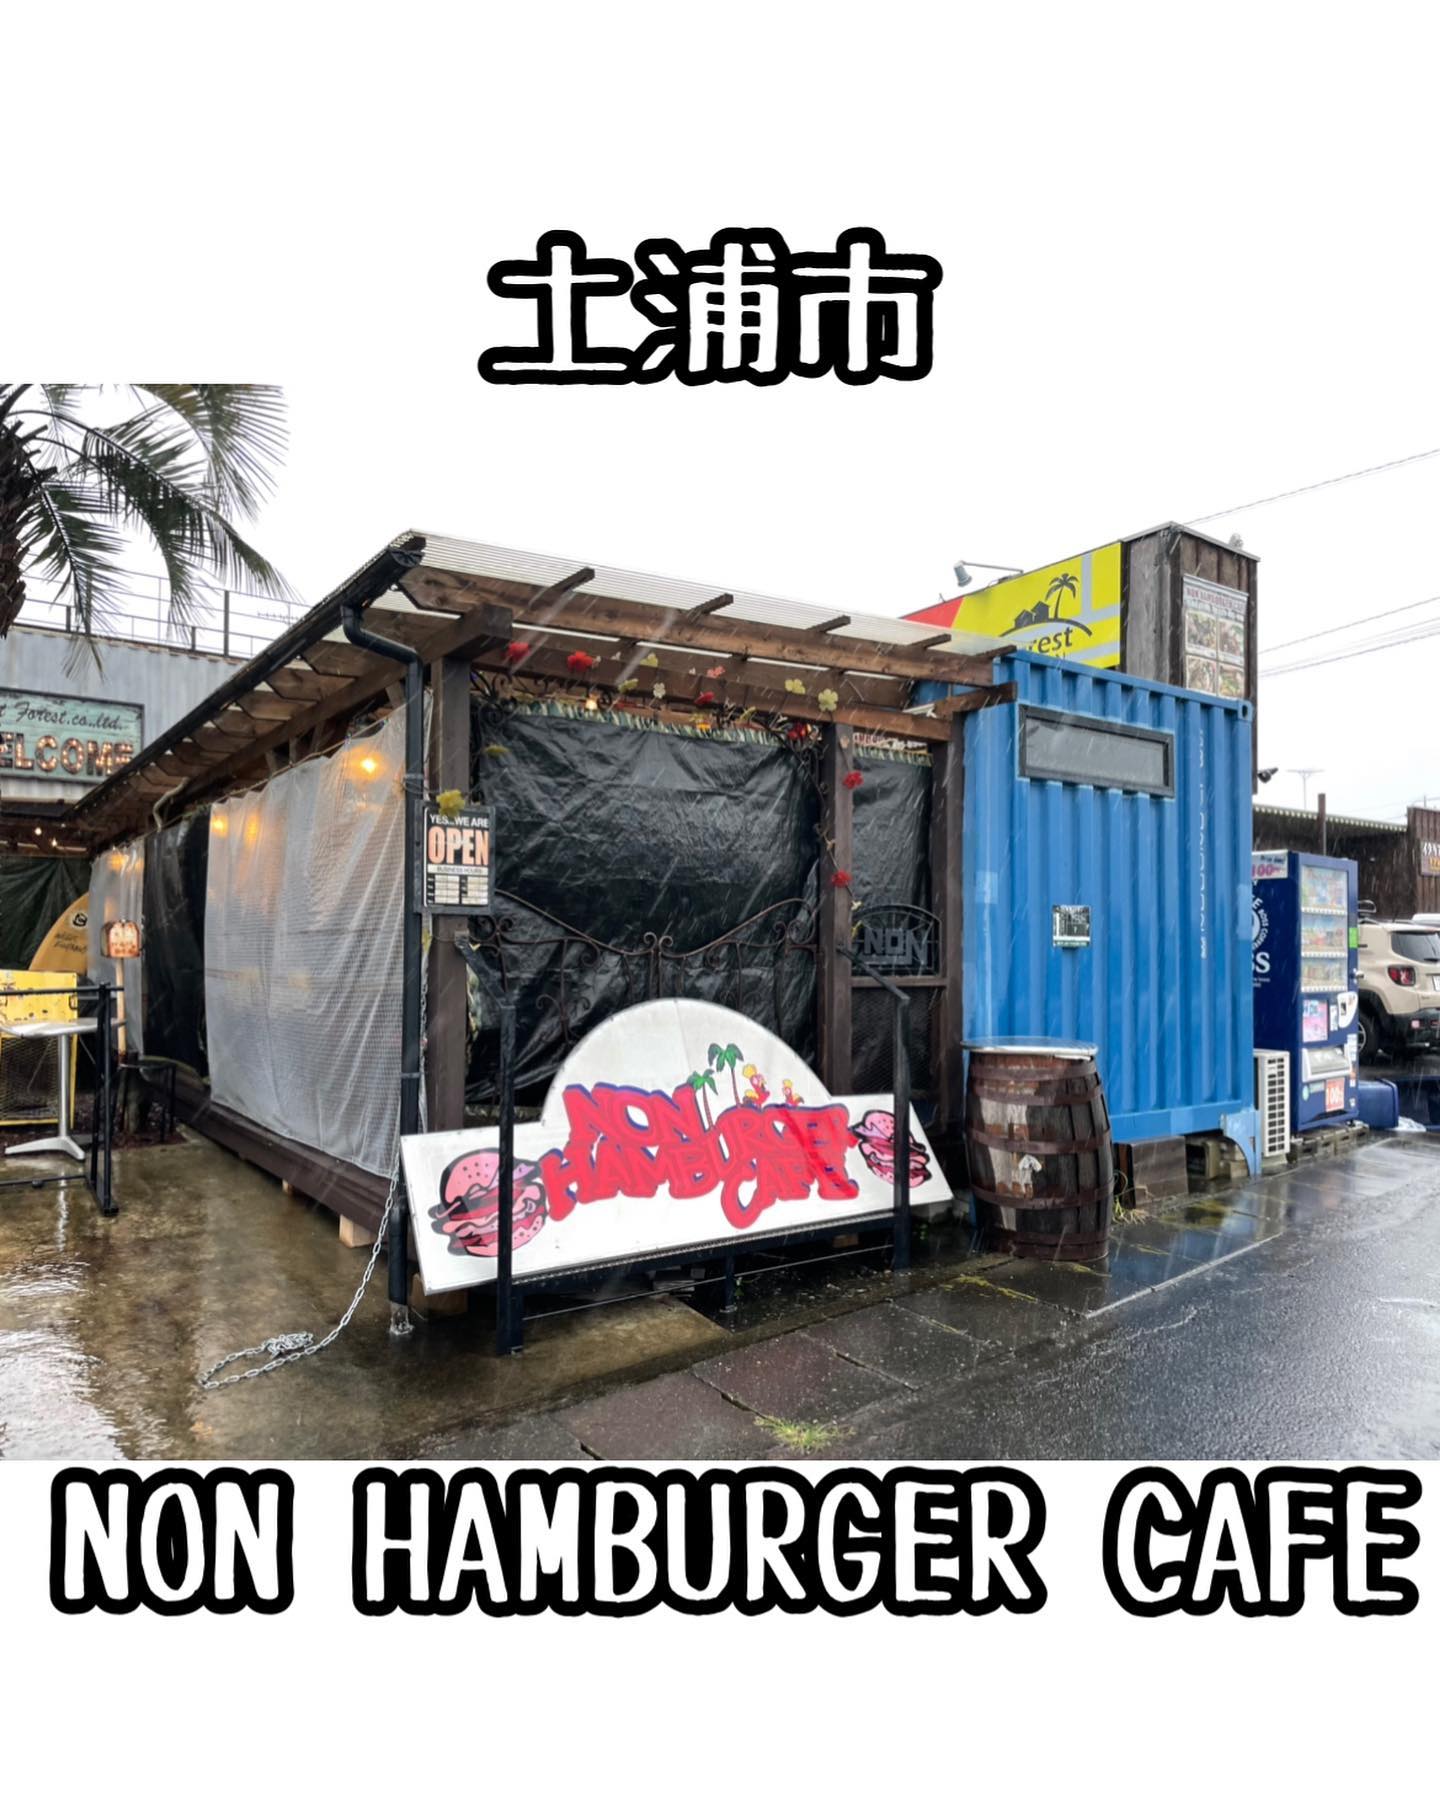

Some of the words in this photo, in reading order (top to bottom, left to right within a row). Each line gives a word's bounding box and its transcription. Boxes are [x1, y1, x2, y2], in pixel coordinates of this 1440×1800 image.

[428, 826, 488, 865] OPEN
[471, 817, 488, 828] ARE
[864, 927, 928, 966] NON
[562, 1082, 703, 1146] NON
[540, 1103, 859, 1222] HAMBURGER
[720, 1150, 860, 1230] CAFE
